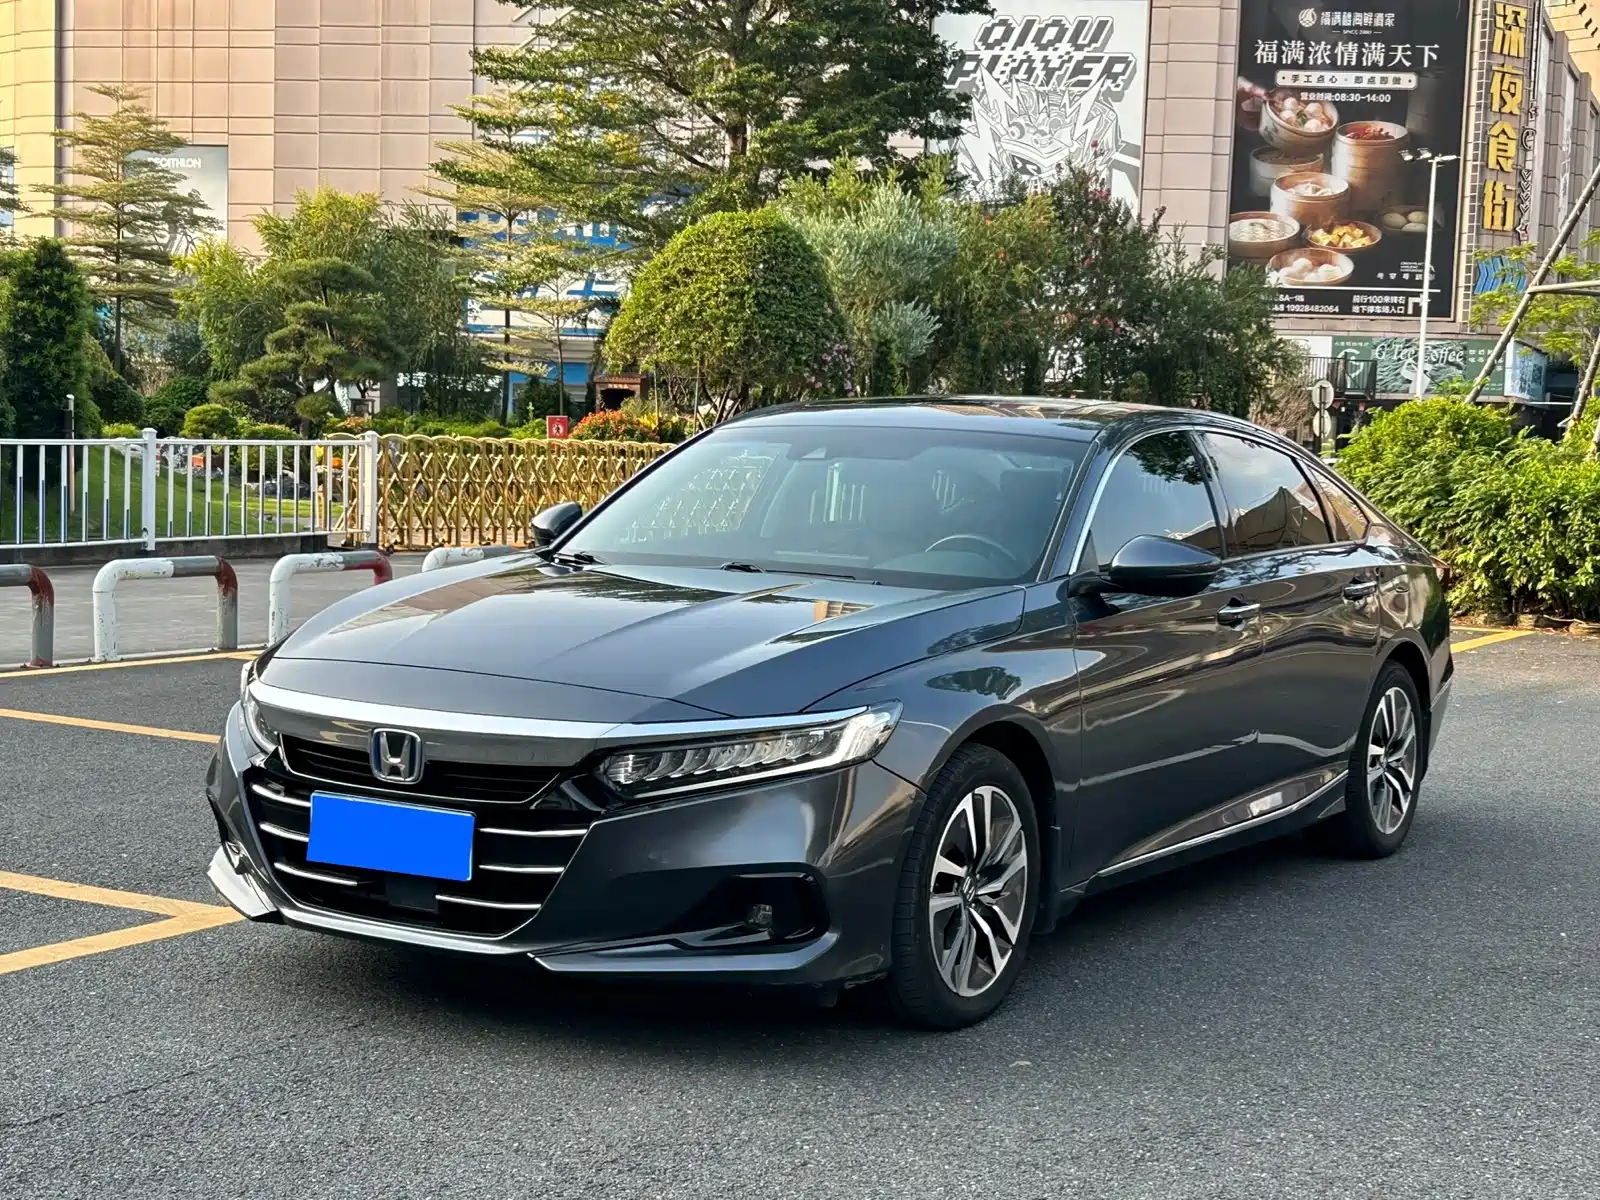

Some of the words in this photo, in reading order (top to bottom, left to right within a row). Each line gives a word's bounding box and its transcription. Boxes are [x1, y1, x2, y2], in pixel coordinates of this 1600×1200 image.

[1254, 39, 1440, 68] 福满浓情满天下
[1291, 74, 1338, 84] 手工点心
[1482, 3, 1528, 232] 深夜食街
